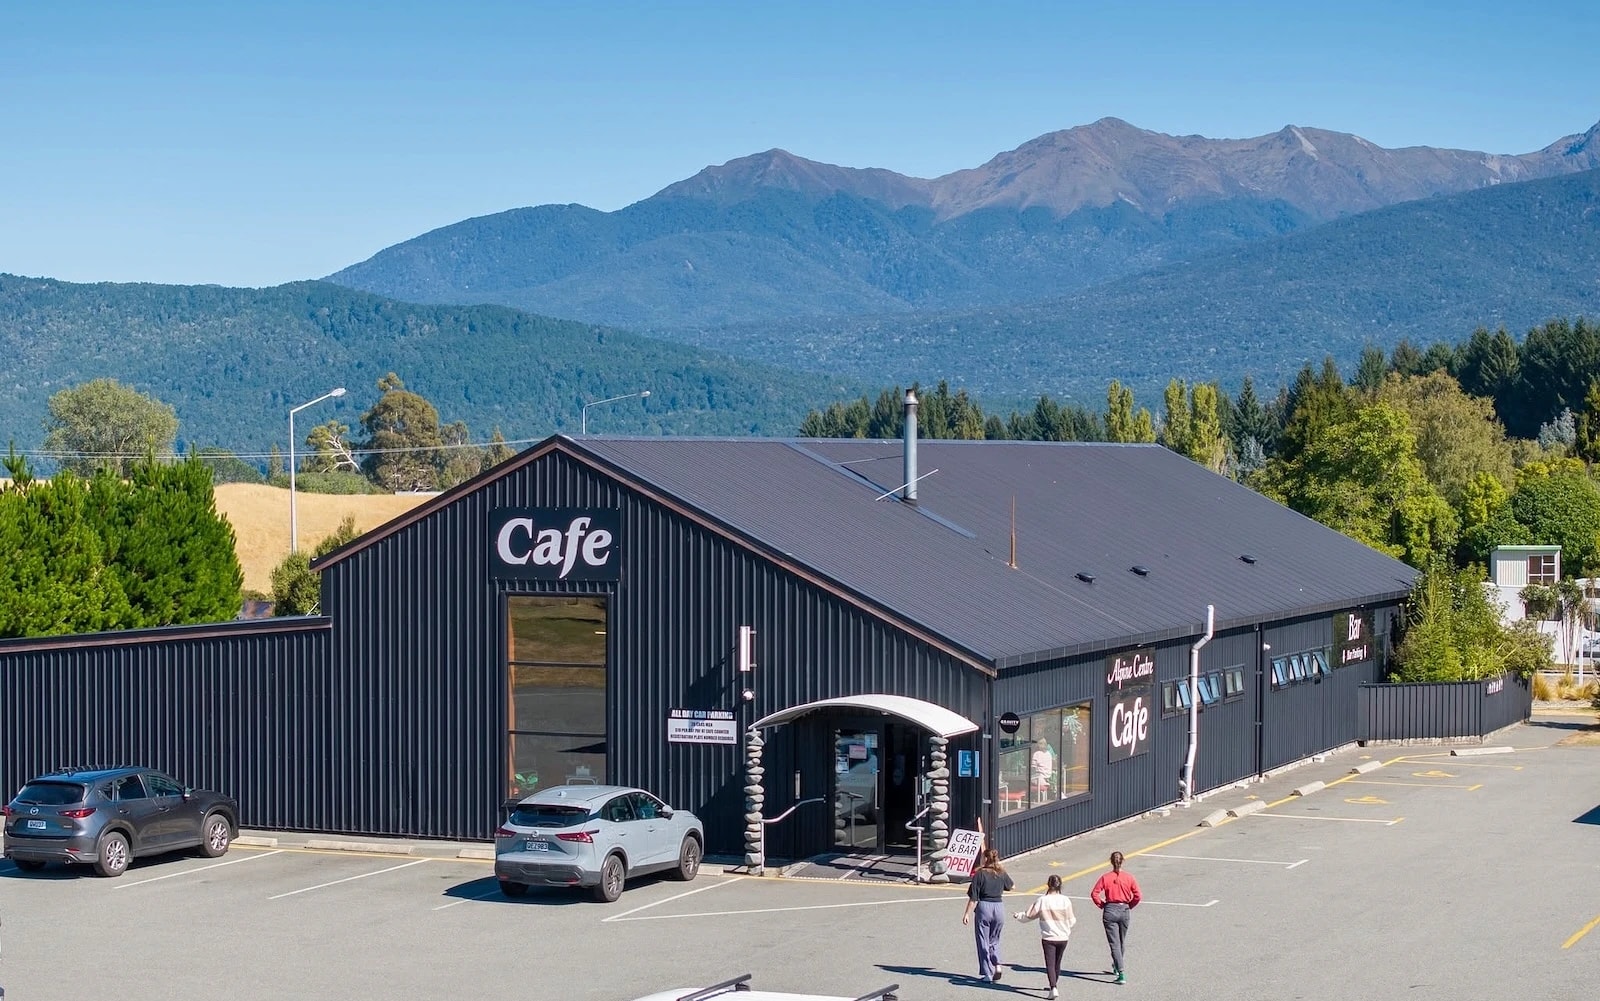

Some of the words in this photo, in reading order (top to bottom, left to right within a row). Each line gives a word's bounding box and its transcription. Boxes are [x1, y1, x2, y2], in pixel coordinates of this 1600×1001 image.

[497, 517, 612, 578] Cafe
[1348, 614, 1362, 640] Bar
[1107, 658, 1133, 690] Alpine
[1133, 654, 1154, 678] Centre
[671, 709, 682, 717] ALL
[682, 710, 694, 718] DAY
[694, 710, 706, 719] CAR
[707, 711, 733, 719] PARKING
[1111, 697, 1148, 756] Cafe
[949, 843, 956, 853] &
[957, 844, 977, 855] BAR
[955, 832, 979, 845] CAFE
